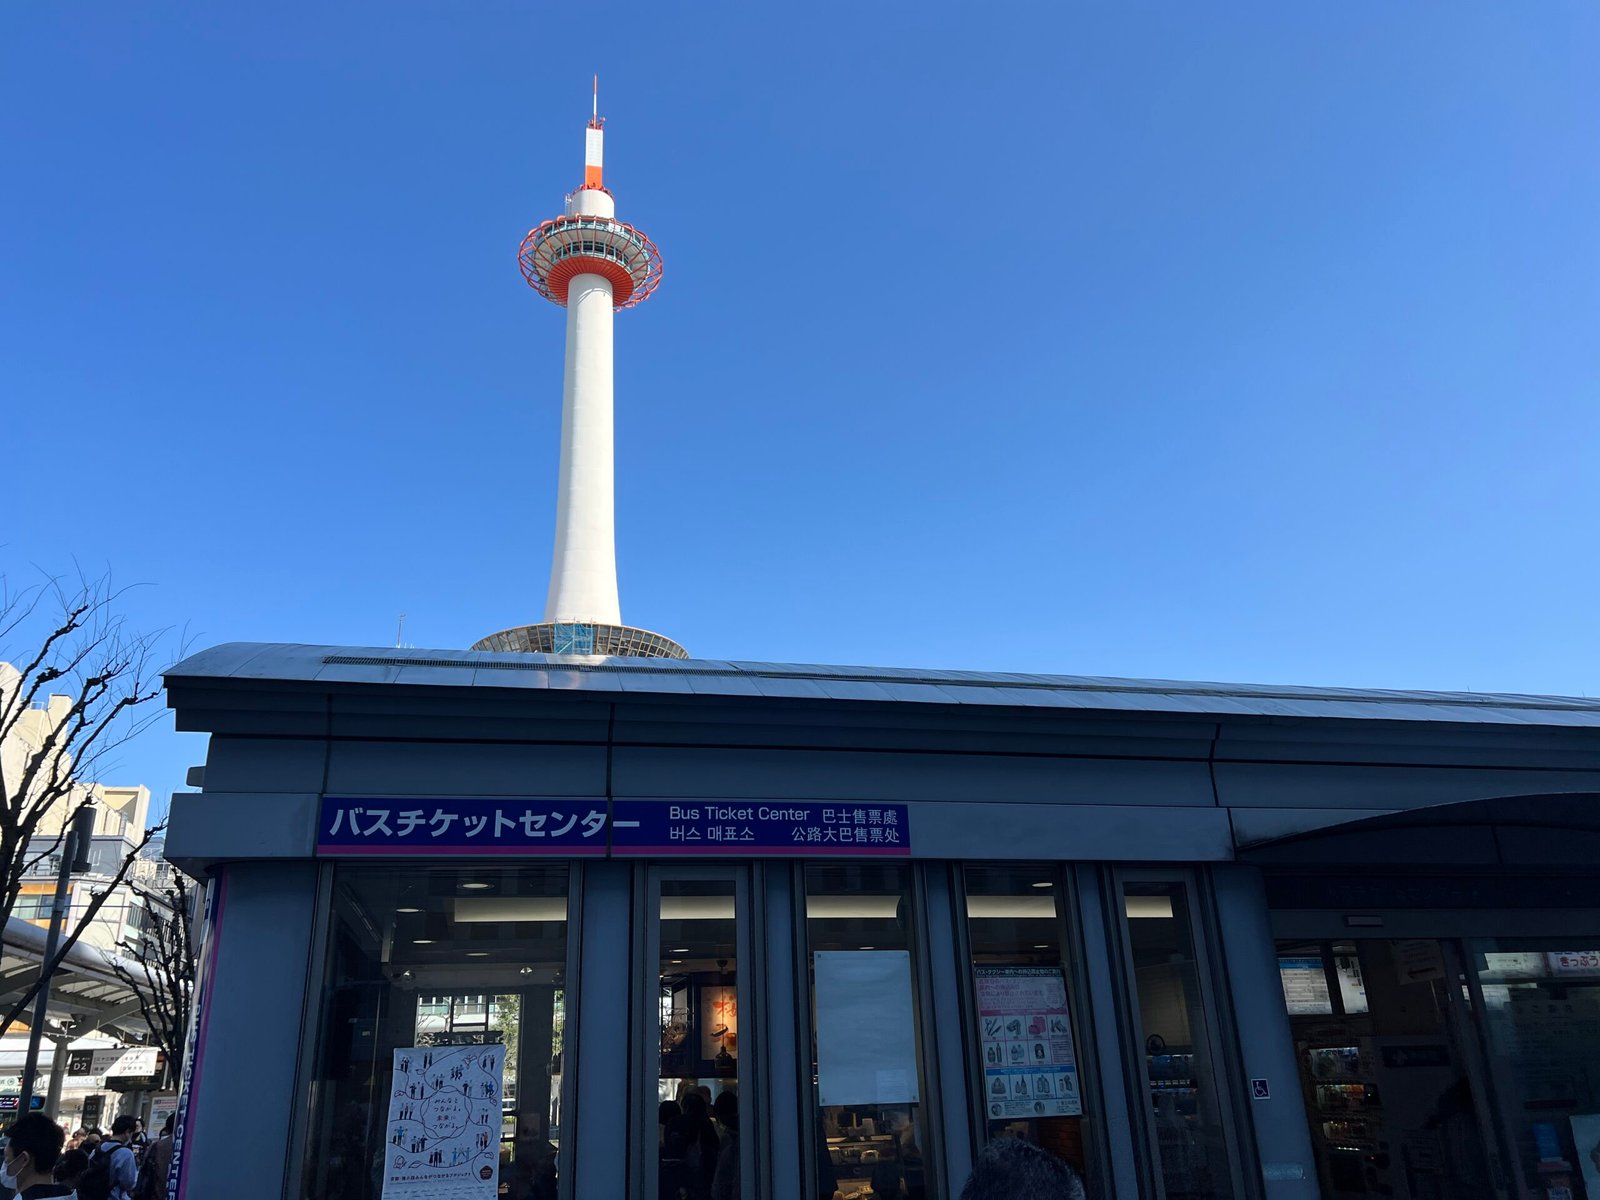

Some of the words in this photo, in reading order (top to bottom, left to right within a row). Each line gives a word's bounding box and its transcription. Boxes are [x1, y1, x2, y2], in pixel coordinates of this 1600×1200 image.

[329, 807, 641, 838] バスチケットセンター
[669, 806, 700, 822] Bus
[703, 806, 755, 822] Ticket
[757, 807, 811, 823] Center
[821, 808, 899, 826] 巴士售票處
[669, 825, 702, 842] 버스
[706, 825, 756, 843] 매표소
[791, 825, 900, 844] 公路大巴售票处
[1559, 955, 1600, 967] きっぷう
[73, 1062, 87, 1071] D2
[179, 1051, 196, 1118] TICKET
[168, 1124, 185, 1200] CENTER
